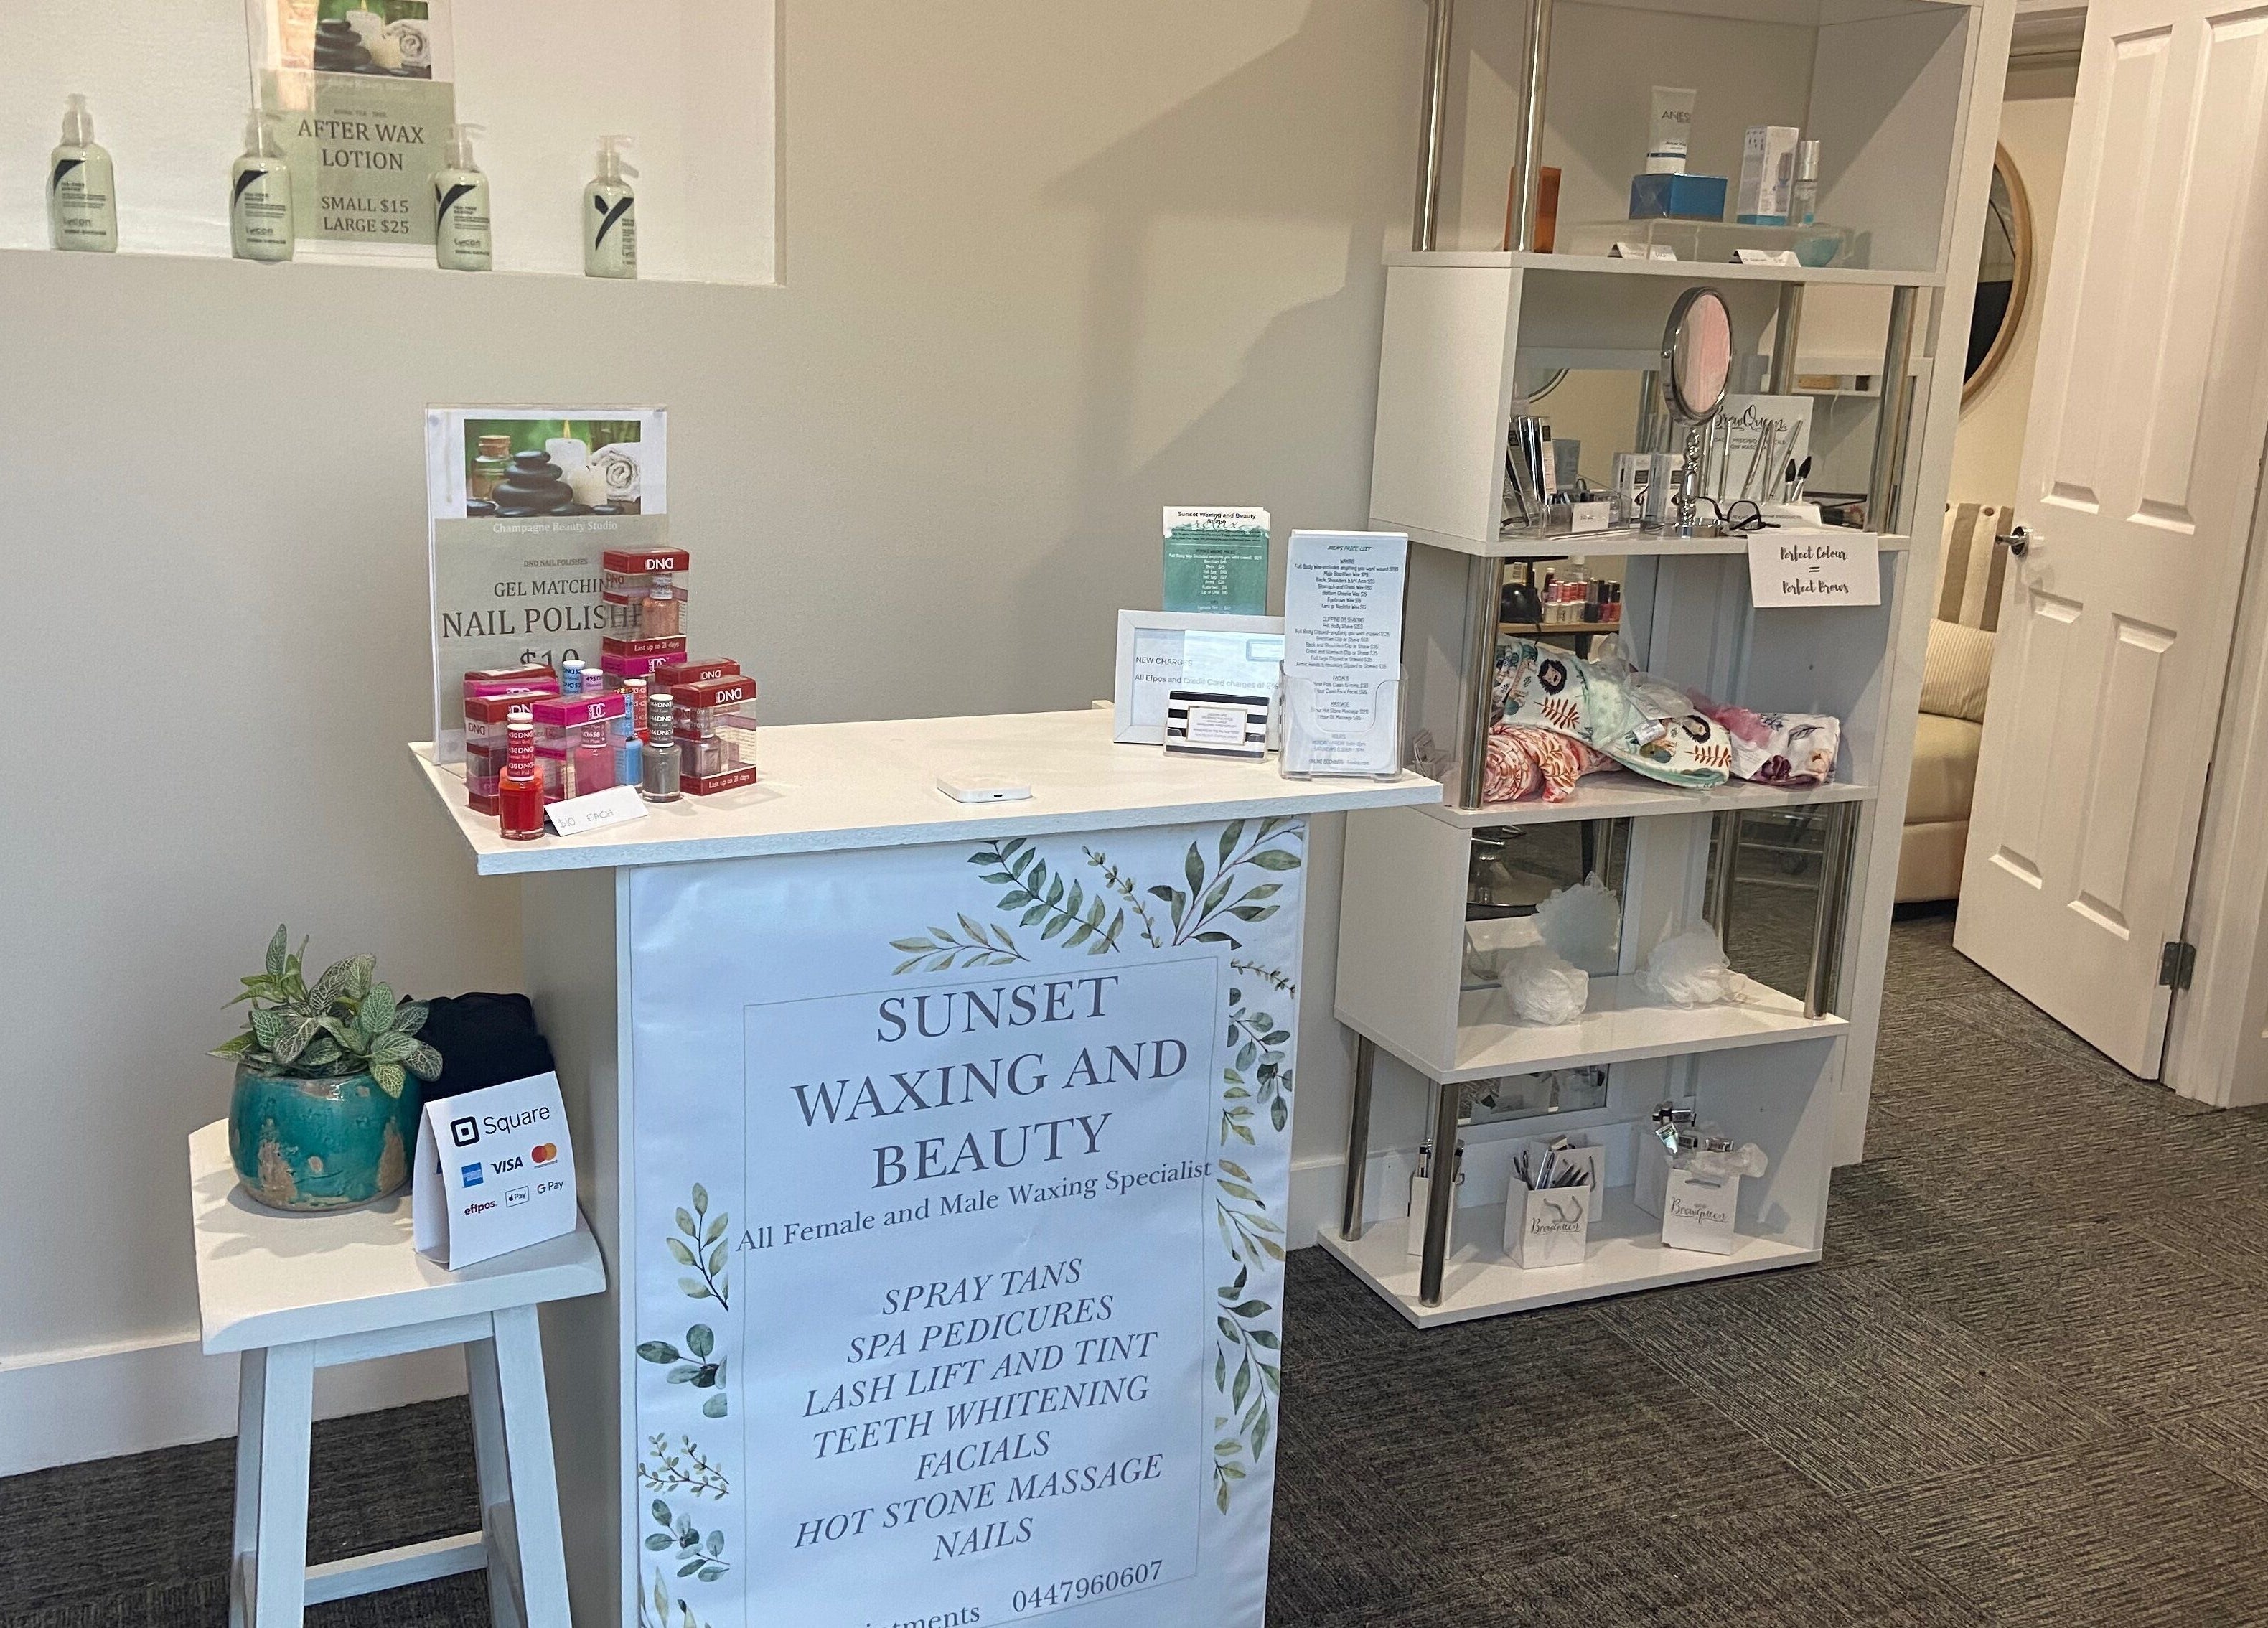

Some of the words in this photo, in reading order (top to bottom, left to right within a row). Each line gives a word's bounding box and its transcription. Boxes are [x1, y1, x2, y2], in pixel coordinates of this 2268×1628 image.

[298, 119, 370, 141] AFTER
[375, 123, 426, 144] WAX
[322, 149, 403, 170] LOTION
[322, 196, 376, 212] SMALL
[380, 199, 408, 213] $15
[324, 217, 377, 233] LARGE
[380, 219, 409, 234] $25
[493, 523, 550, 534] Champagne
[553, 522, 585, 533] Beauty
[588, 520, 617, 530] Studio
[1780, 544, 1813, 562] Perfect
[1817, 546, 1847, 561] Colour
[647, 558, 673, 570] DND
[494, 581, 527, 597] GEL
[532, 578, 616, 596] MATCHIN
[1782, 578, 1815, 595] Perfect
[1818, 580, 1849, 594] Brows
[443, 609, 515, 638] NAIL
[525, 603, 643, 633] POLISHE
[667, 640, 679, 649] days
[1156, 658, 1193, 666] CHARGES
[701, 669, 721, 680] DND
[1227, 680, 1255, 690] charges
[718, 688, 742, 703] DND
[511, 702, 532, 714] DN
[468, 722, 485, 736] DND
[708, 780, 720, 788] Last
[557, 817, 576, 828] $10
[586, 809, 614, 822] EACH
[877, 975, 1118, 1044] SUNSET
[790, 1053, 1049, 1127] WAXING
[1062, 1038, 1189, 1090] AND
[483, 1106, 550, 1135] Square
[871, 1112, 1112, 1189] BEAUTY
[491, 1156, 524, 1174] VISA
[548, 1180, 564, 1191] Pay
[514, 1192, 526, 1201] Pay
[464, 1200, 497, 1215] eftpos
[736, 1227, 773, 1253] All
[784, 1211, 875, 1248] Female
[884, 1198, 930, 1226] and
[940, 1189, 999, 1217] Male
[1008, 1176, 1099, 1206] Waxing
[1105, 1160, 1212, 1195] Specialist
[882, 1273, 995, 1316] SPRAY
[1001, 1258, 1083, 1297] TANS
[847, 1329, 907, 1365] SPA
[919, 1294, 1115, 1352] PEDICURES
[803, 1374, 897, 1418] LASH
[906, 1358, 985, 1398] LIFT
[990, 1344, 1064, 1381] AND
[1074, 1332, 1158, 1366] TINT
[812, 1410, 935, 1460] TEETH
[945, 1374, 1151, 1433] WHITENING
[914, 1430, 1051, 1482] FACIALS
[794, 1507, 876, 1550] HOT
[882, 1480, 998, 1530] STONE
[1006, 1454, 1164, 1505] MASSAGE
[933, 1517, 1034, 1561] NAILS
[1012, 1560, 1163, 1614] 0447960607
